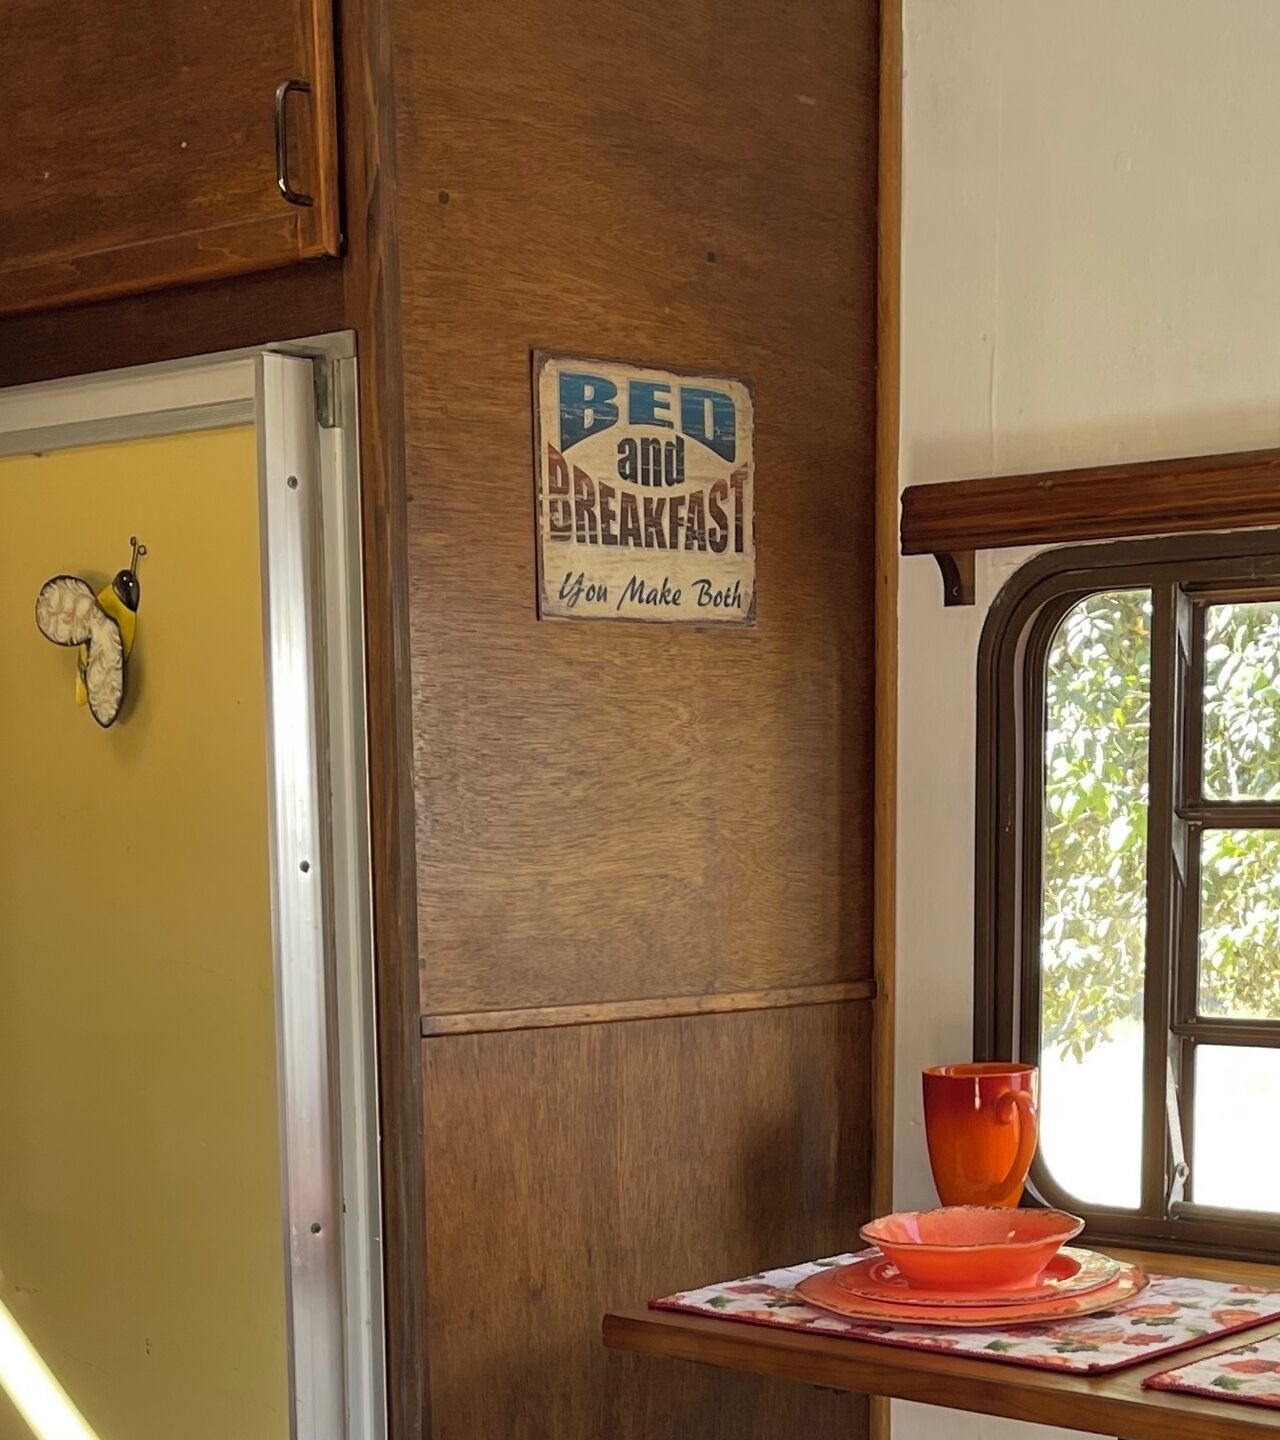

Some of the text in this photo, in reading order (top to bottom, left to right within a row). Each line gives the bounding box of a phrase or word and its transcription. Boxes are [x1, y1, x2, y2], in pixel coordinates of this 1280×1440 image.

[558, 371, 736, 463] BED
[548, 442, 749, 553] BREAKFAST
[617, 434, 685, 488] and
[558, 571, 742, 611] You Make Both
